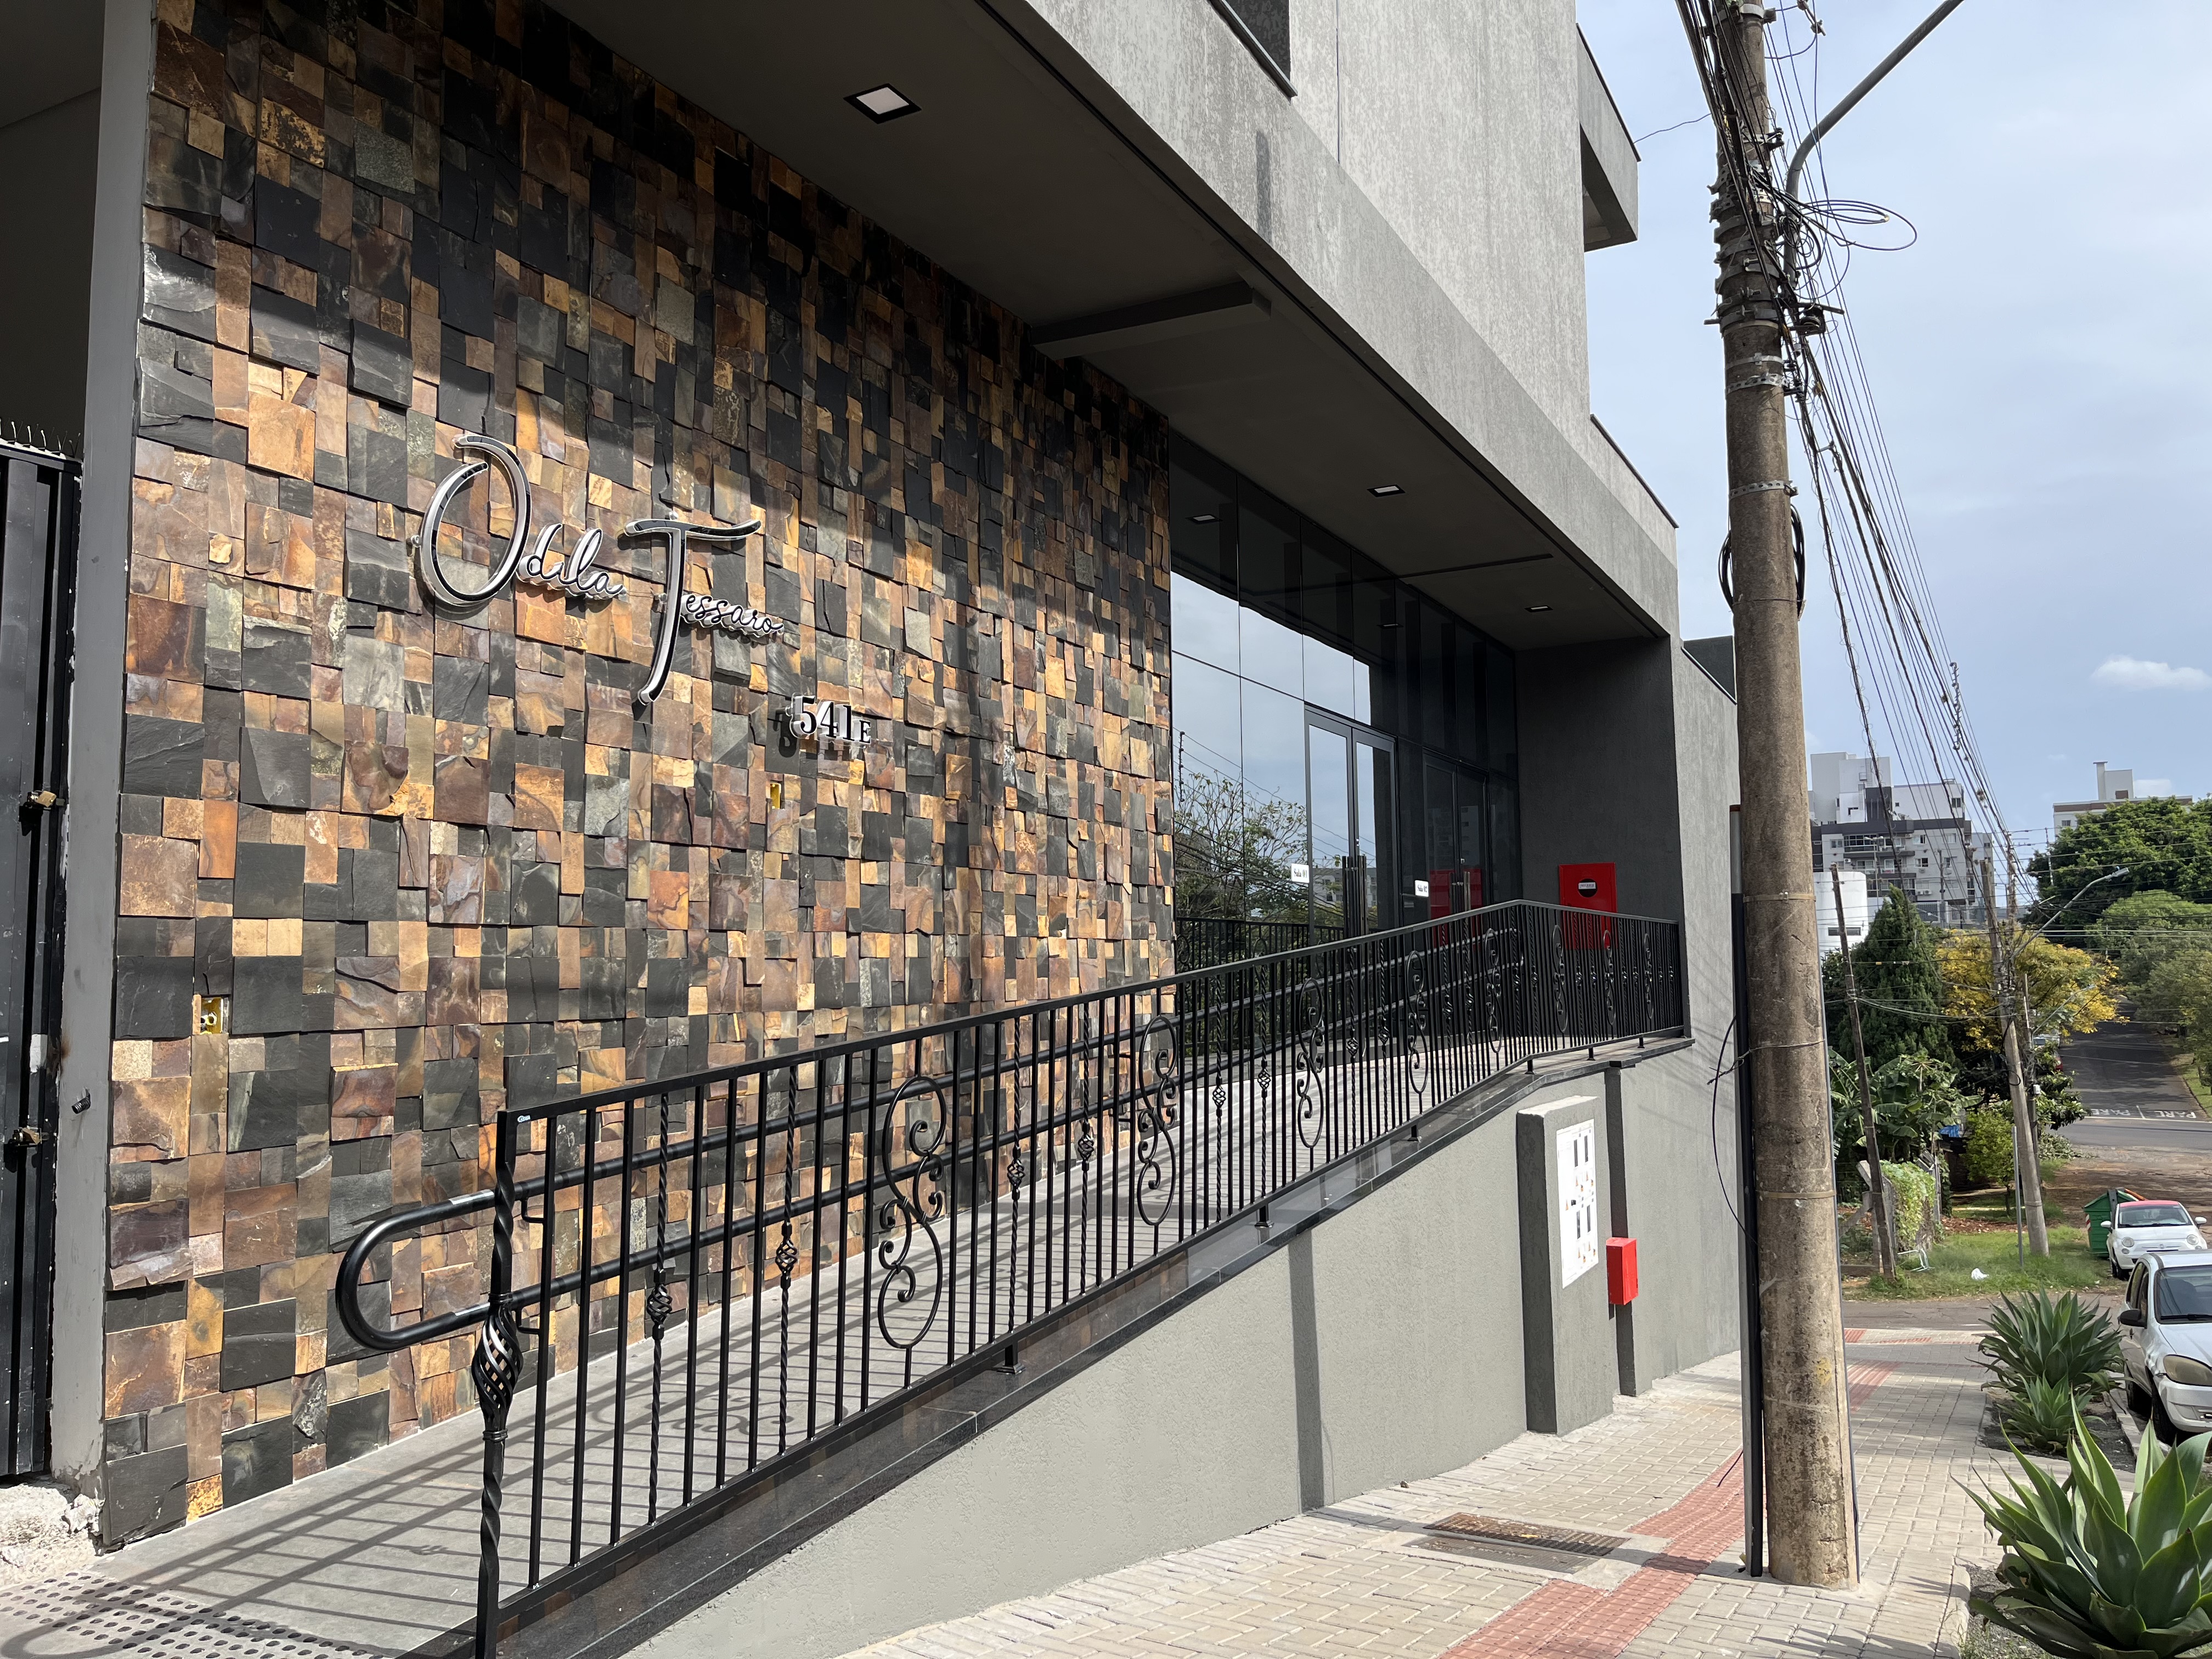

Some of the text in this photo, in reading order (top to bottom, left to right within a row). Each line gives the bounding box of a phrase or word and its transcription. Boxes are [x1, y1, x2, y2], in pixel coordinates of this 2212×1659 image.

[420, 434, 785, 706] Odila Tessaro
[1302, 869, 1308, 878] 01
[2154, 1110, 2197, 1119] PARE
